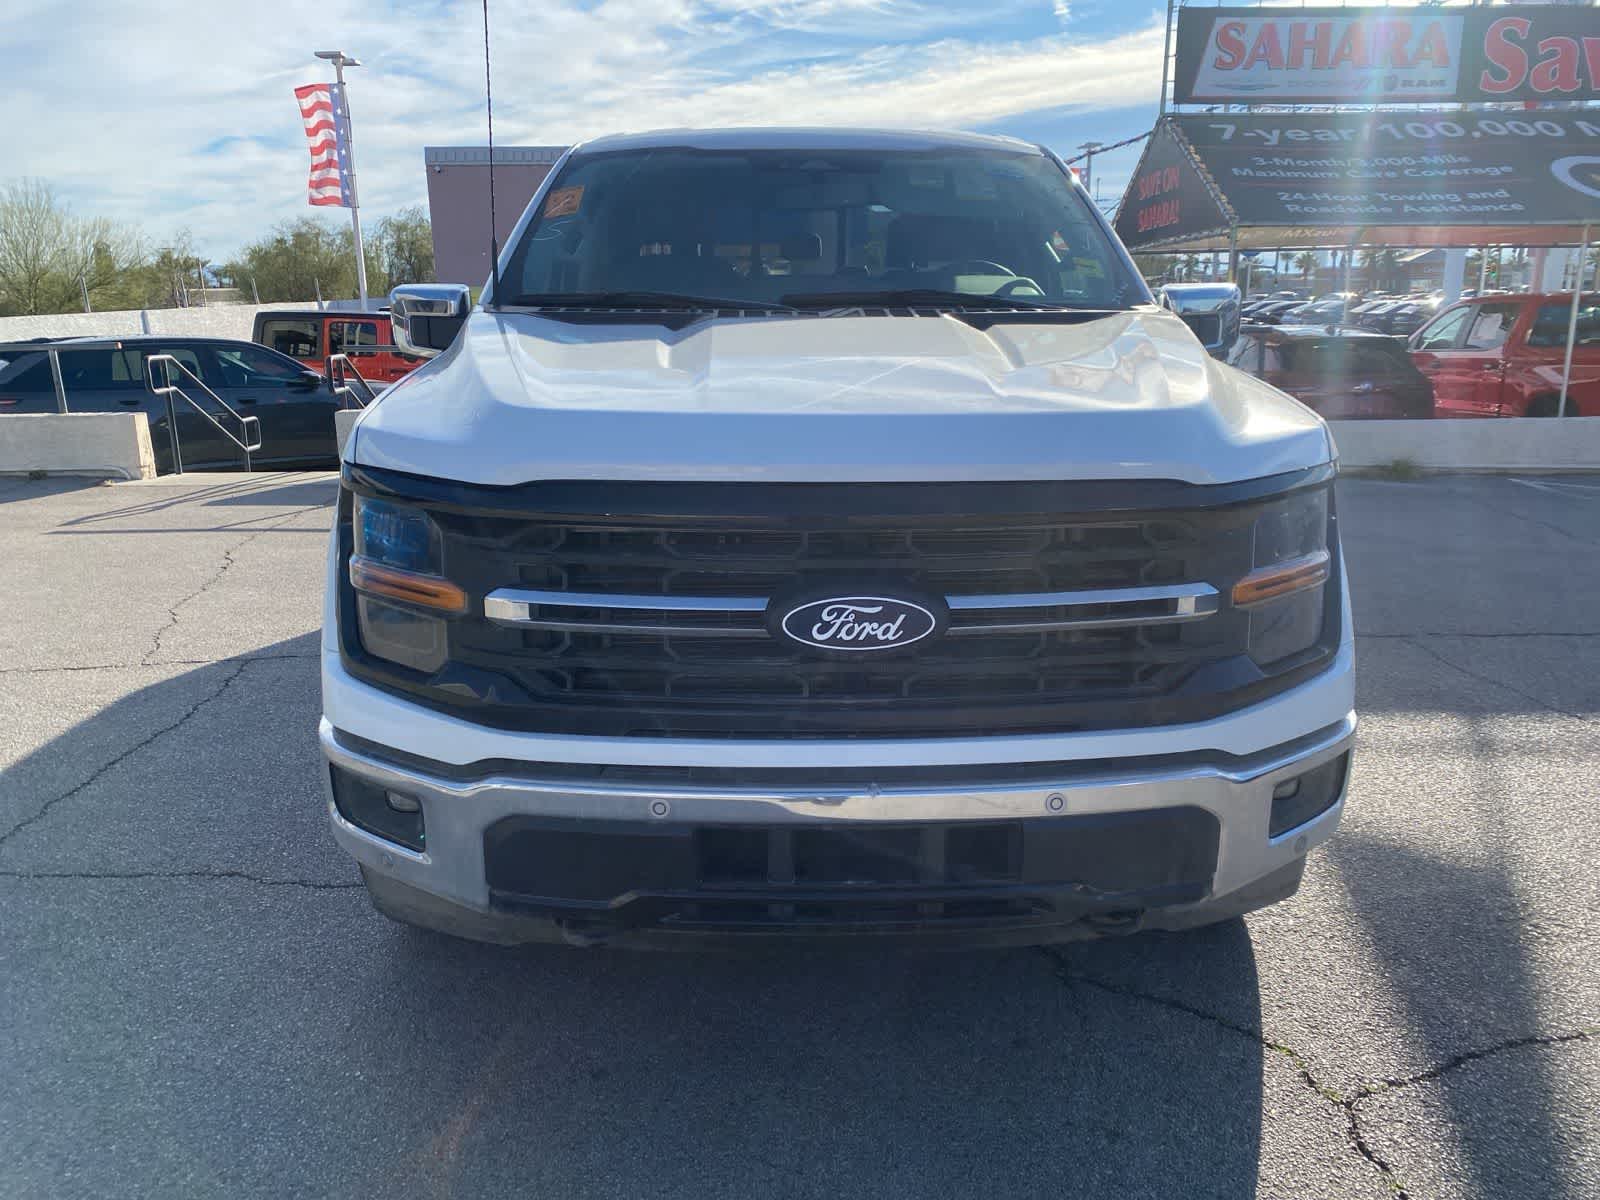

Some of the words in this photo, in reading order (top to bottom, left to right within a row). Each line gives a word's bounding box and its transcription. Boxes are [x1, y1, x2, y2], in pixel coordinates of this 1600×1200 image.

[1214, 21, 1450, 71] SAHARA
[1231, 167, 1341, 178] Maximum
[1404, 166, 1513, 177] Coverage
[1376, 192, 1461, 202] Towing
[1467, 189, 1511, 199] and
[812, 604, 906, 641] Ford
